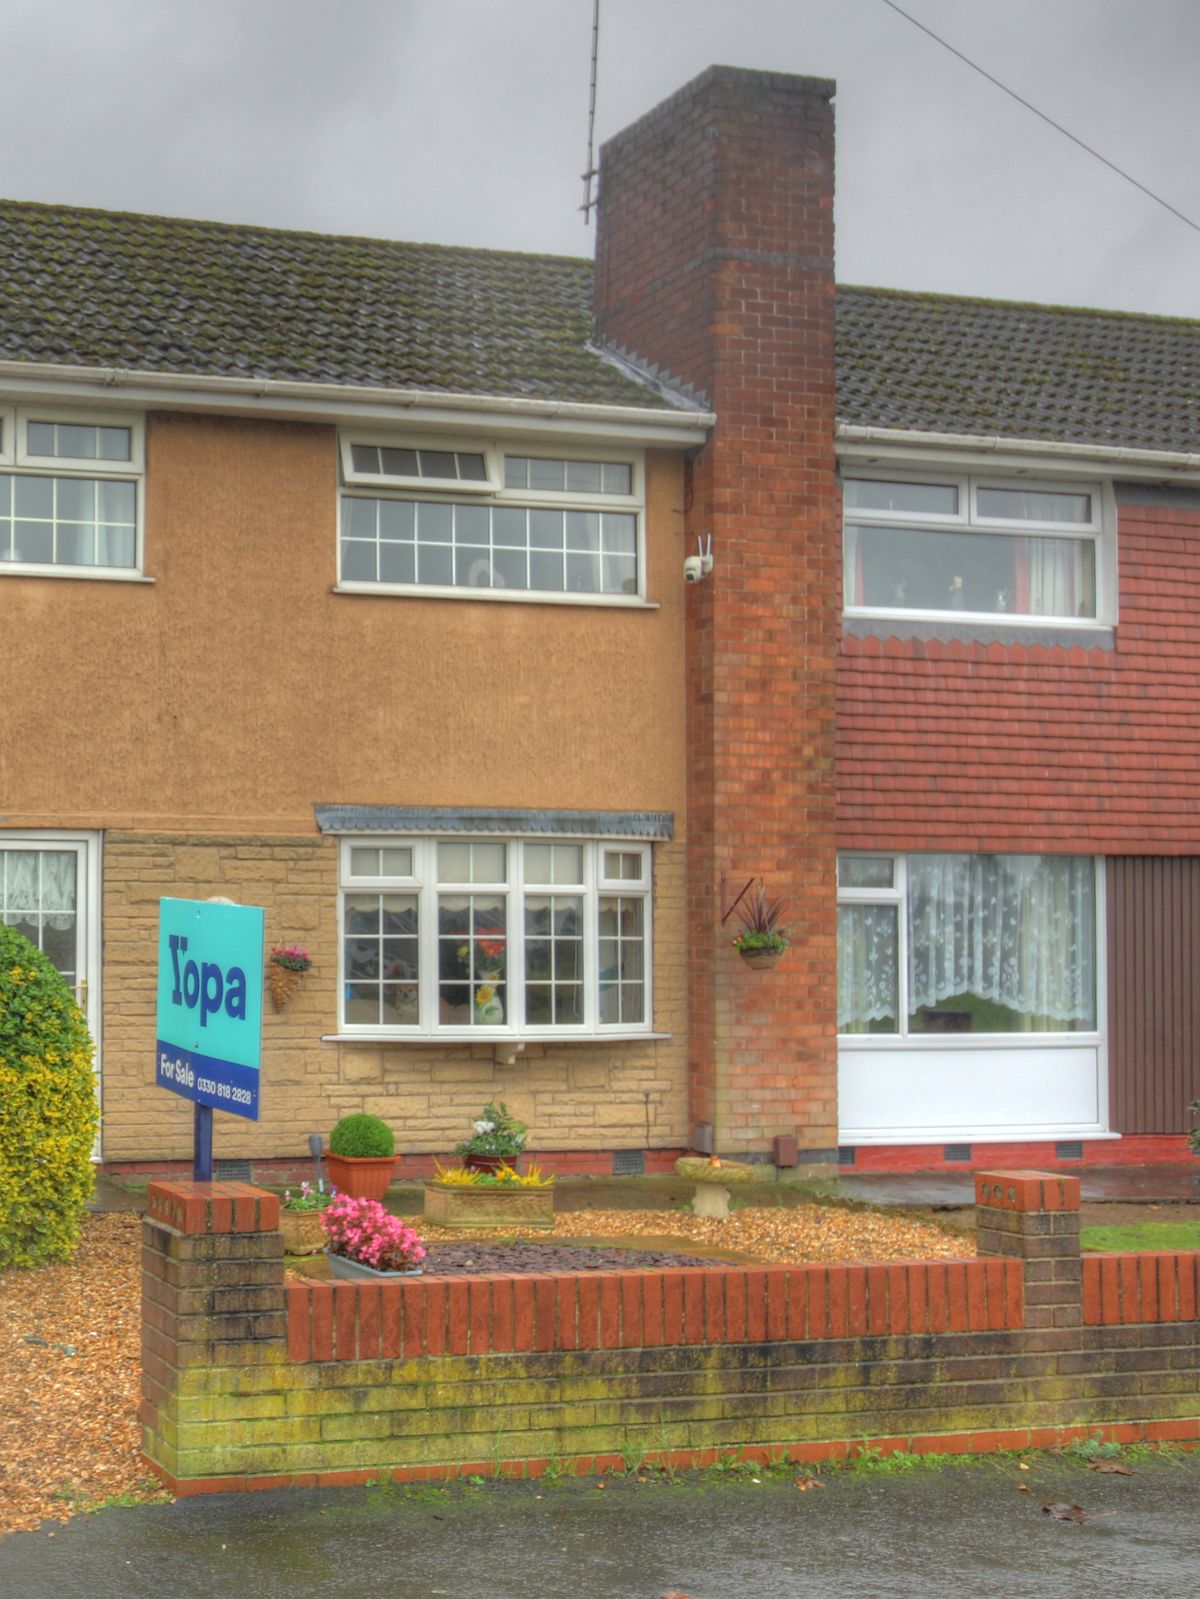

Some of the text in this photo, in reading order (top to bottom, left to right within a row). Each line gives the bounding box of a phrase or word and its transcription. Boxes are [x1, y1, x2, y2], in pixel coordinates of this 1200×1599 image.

[169, 934, 246, 1027] Yopa
[161, 1053, 252, 1105] For Sale 0330 818 2828
